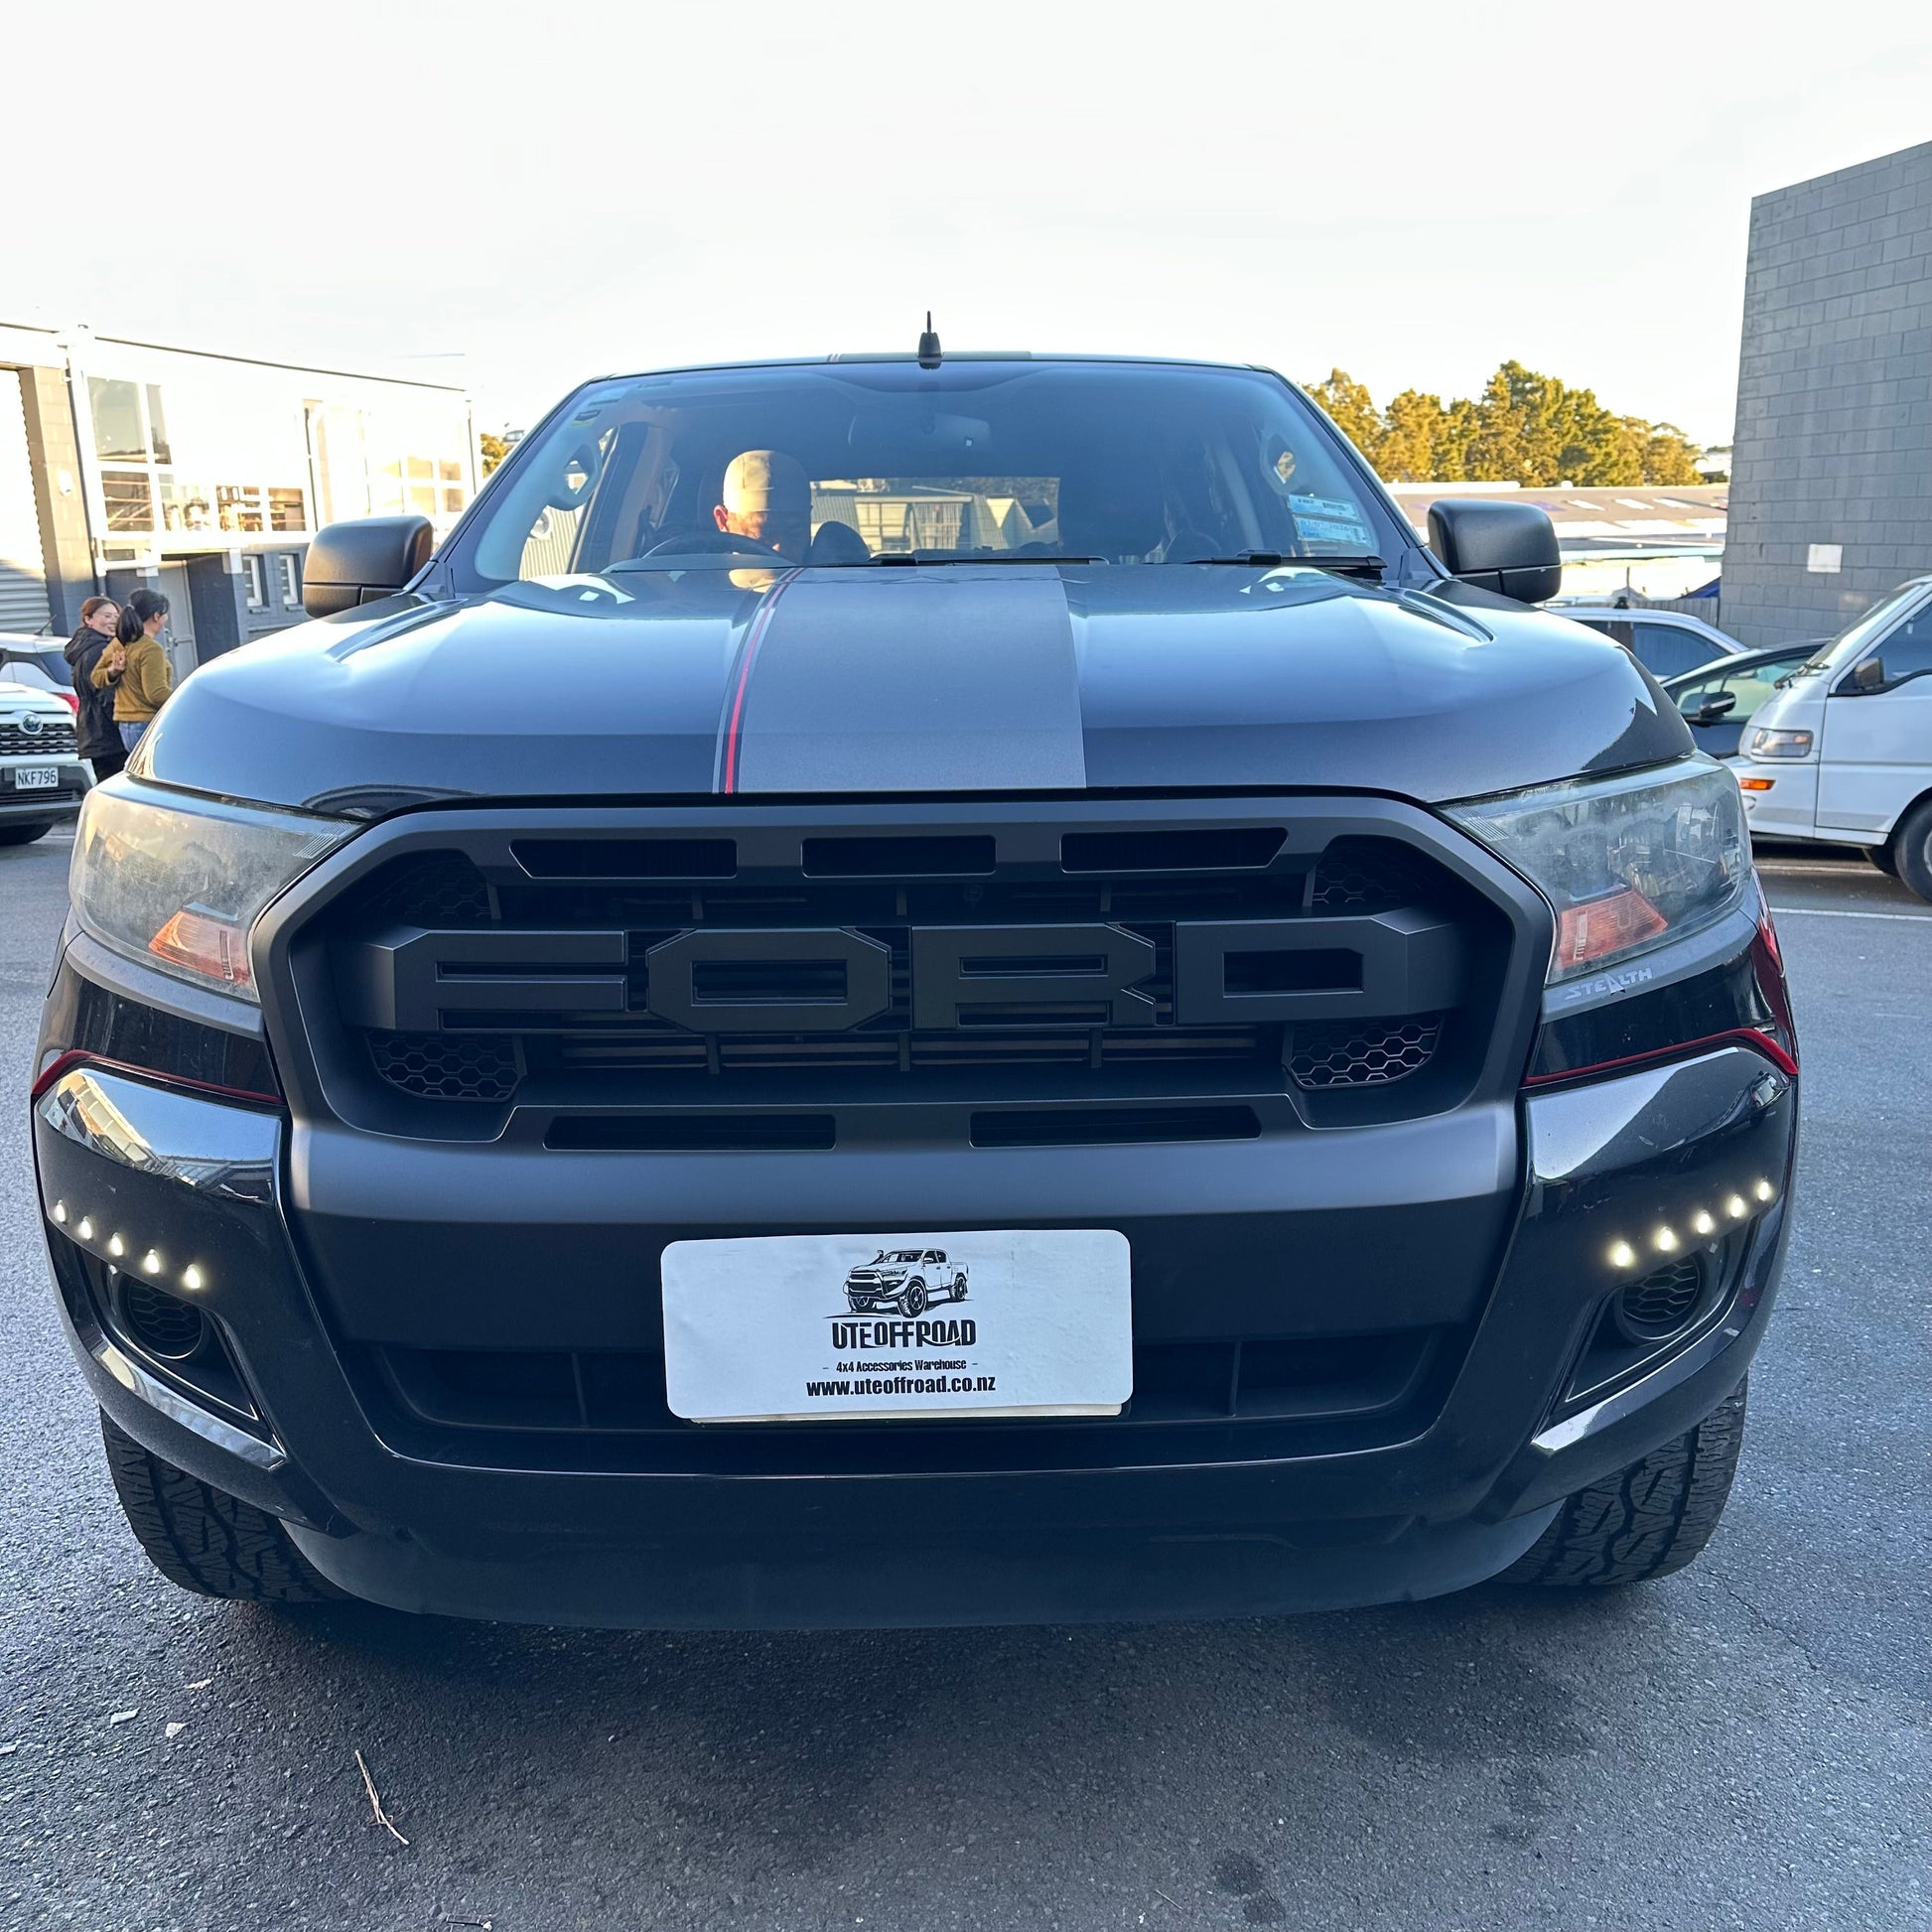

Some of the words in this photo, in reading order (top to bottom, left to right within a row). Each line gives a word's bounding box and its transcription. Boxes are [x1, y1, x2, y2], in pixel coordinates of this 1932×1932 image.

[17, 769, 57, 786] NKF796
[371, 911, 1463, 1033] FORD
[1565, 967, 1653, 1000] STEALTH
[836, 1361, 855, 1373] 4x4
[856, 1359, 913, 1373] Accessories
[914, 1358, 967, 1371] Warehouse
[806, 1376, 996, 1396] www.uteoffroad.co.nz
